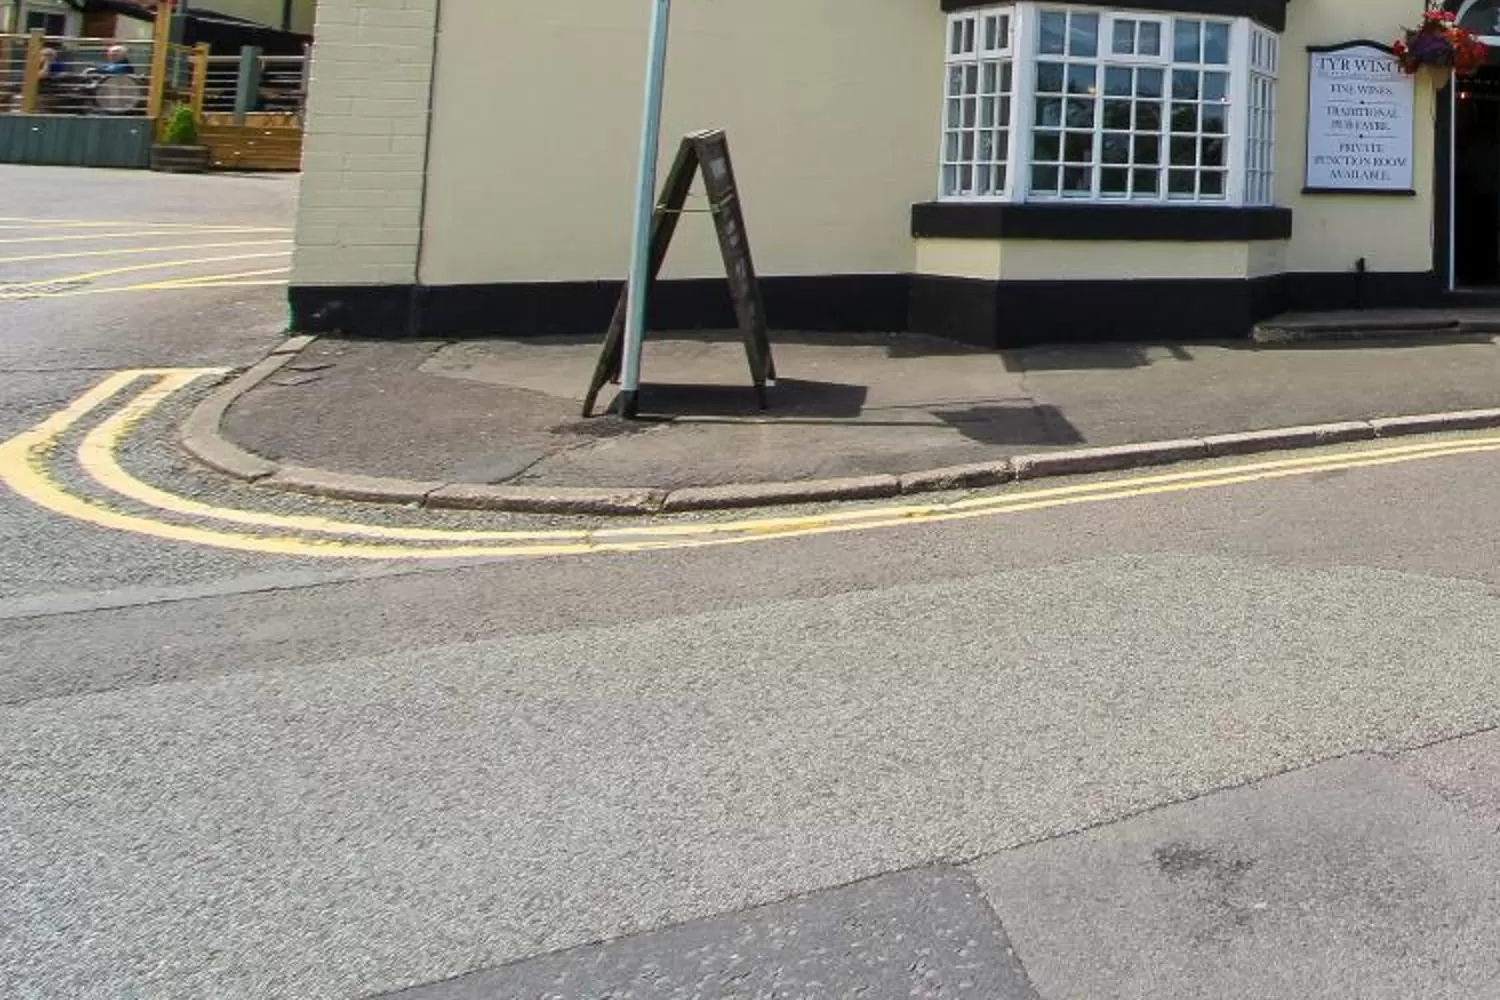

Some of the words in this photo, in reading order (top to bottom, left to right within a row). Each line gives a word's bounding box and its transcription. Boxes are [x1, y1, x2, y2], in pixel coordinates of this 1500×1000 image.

[1327, 106, 1397, 118] TRADITIONAL
[1339, 143, 1383, 152] PRIVATE
[1315, 155, 1370, 166] FUNCTION
